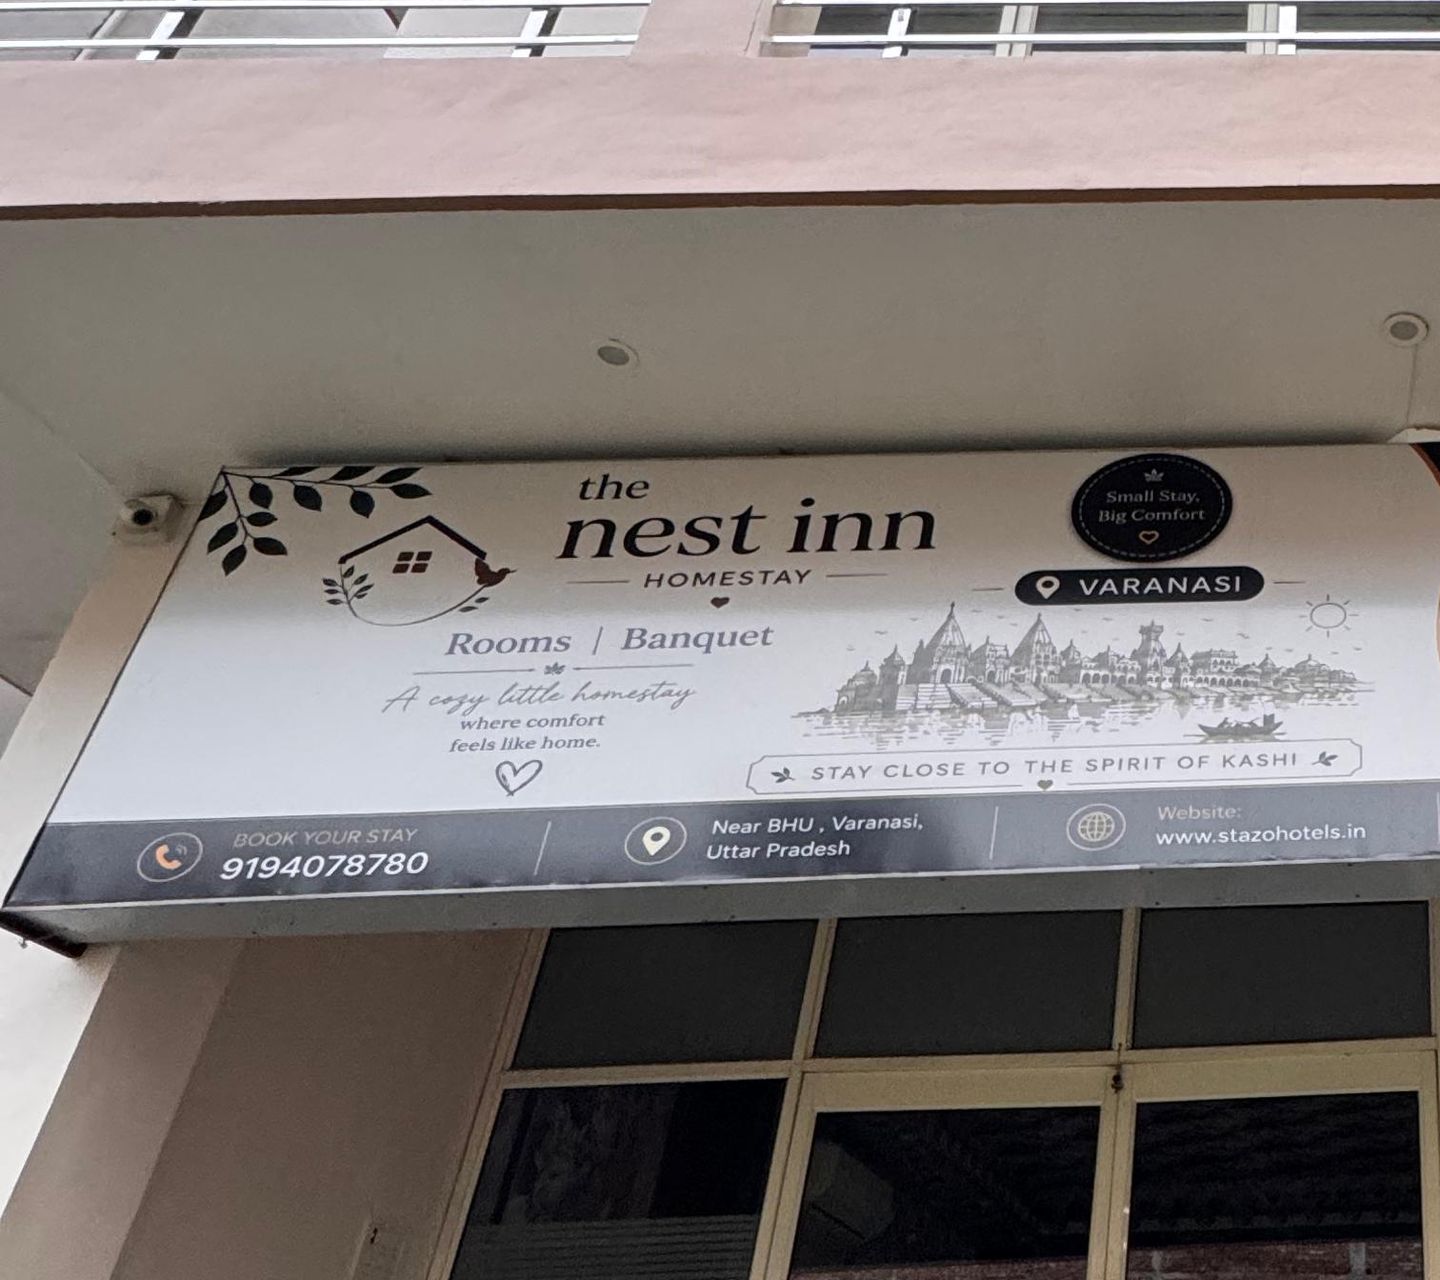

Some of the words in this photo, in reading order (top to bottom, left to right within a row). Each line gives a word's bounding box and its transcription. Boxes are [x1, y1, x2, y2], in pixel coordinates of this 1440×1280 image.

[578, 473, 649, 500] the
[1106, 490, 1155, 505] Small
[1099, 510, 1127, 525] Big
[1131, 508, 1206, 522] Comfort
[555, 504, 767, 559] nest
[786, 497, 936, 553] inn
[643, 569, 812, 589] HOMESTAY
[1079, 575, 1243, 597] VARANASI
[444, 632, 571, 656] Rooms
[620, 625, 774, 655] Banquet
[381, 686, 421, 714] A
[428, 693, 489, 716] cozy
[498, 682, 564, 707] little
[571, 680, 696, 710] homestay
[460, 713, 521, 731] where
[526, 713, 606, 730] comfort
[448, 736, 496, 754] feels
[500, 734, 538, 751] like
[541, 733, 601, 751] home.
[811, 765, 872, 780] STAY
[883, 762, 966, 778] CLOSE
[978, 761, 1010, 776] TO
[1024, 759, 1073, 774] THE
[1085, 756, 1166, 772] SPIRIT
[1177, 754, 1210, 770] OF
[1222, 753, 1297, 768] KASHI
[711, 819, 762, 835] Near
[767, 816, 814, 833] BHU
[832, 813, 924, 832] Varanasi,
[1157, 805, 1242, 821] Website:
[232, 831, 298, 848] BOOK
[303, 829, 362, 846] YOUR
[366, 827, 418, 844] STAY
[1155, 822, 1367, 845] www.stazohotels.in
[706, 841, 760, 860] Uttar
[766, 840, 850, 858] Pradesh
[219, 851, 429, 881] 9194078780
